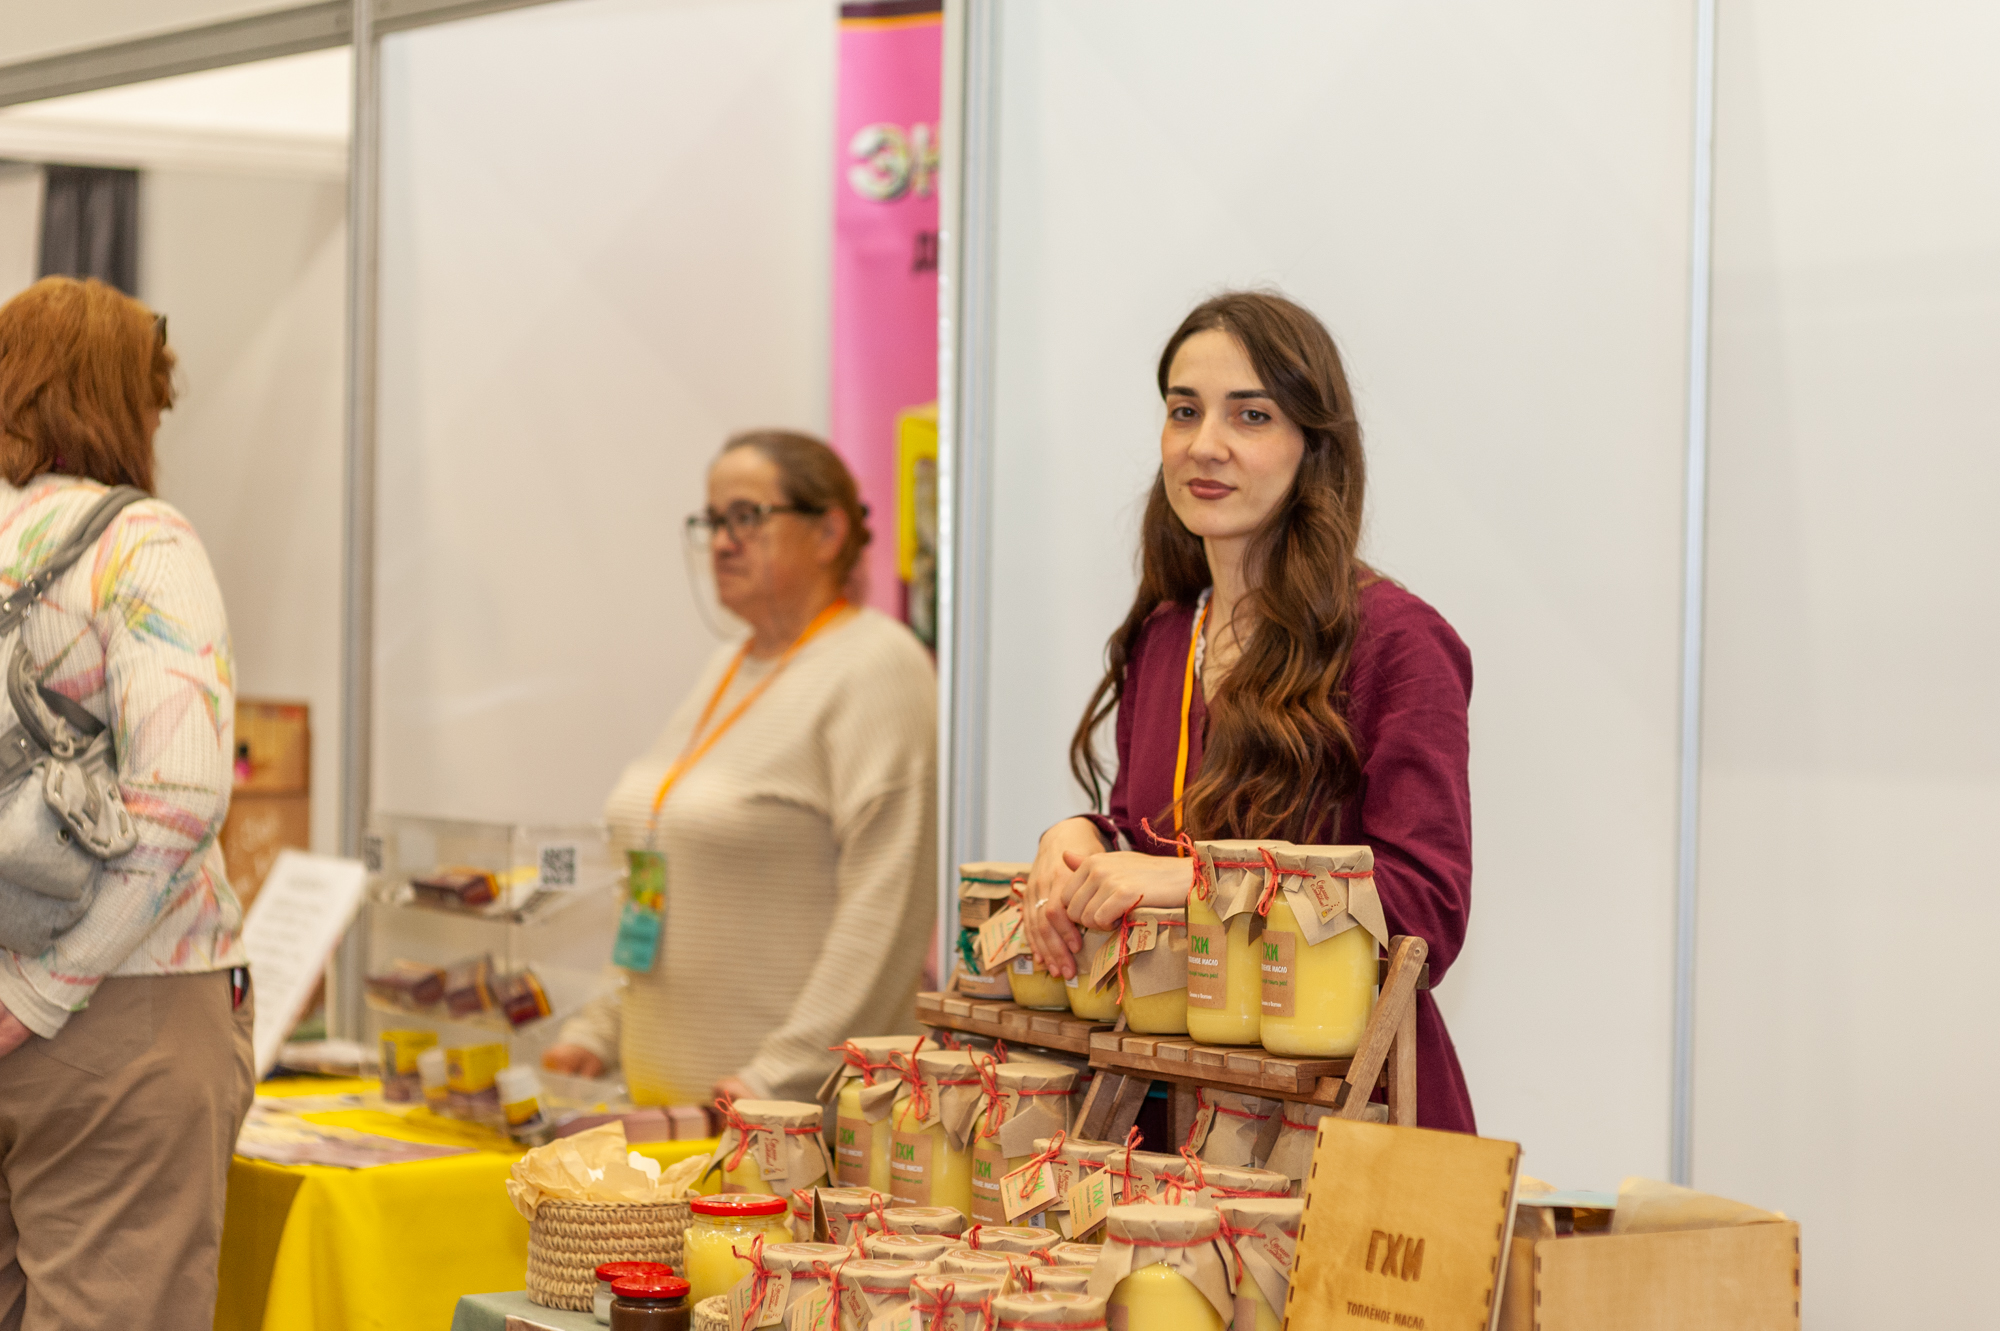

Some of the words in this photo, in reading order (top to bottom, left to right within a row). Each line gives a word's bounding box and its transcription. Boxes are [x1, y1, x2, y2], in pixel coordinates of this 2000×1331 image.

[1191, 935, 1209, 954] ГХИ
[1263, 942, 1279, 961] ГХИ
[895, 1142, 915, 1162] ГХИ
[975, 1159, 992, 1179] ГХИ
[1092, 1180, 1104, 1209] ГХИ
[1365, 1229, 1425, 1282] ГХИ
[1393, 1312, 1425, 1331] МАСЛО
